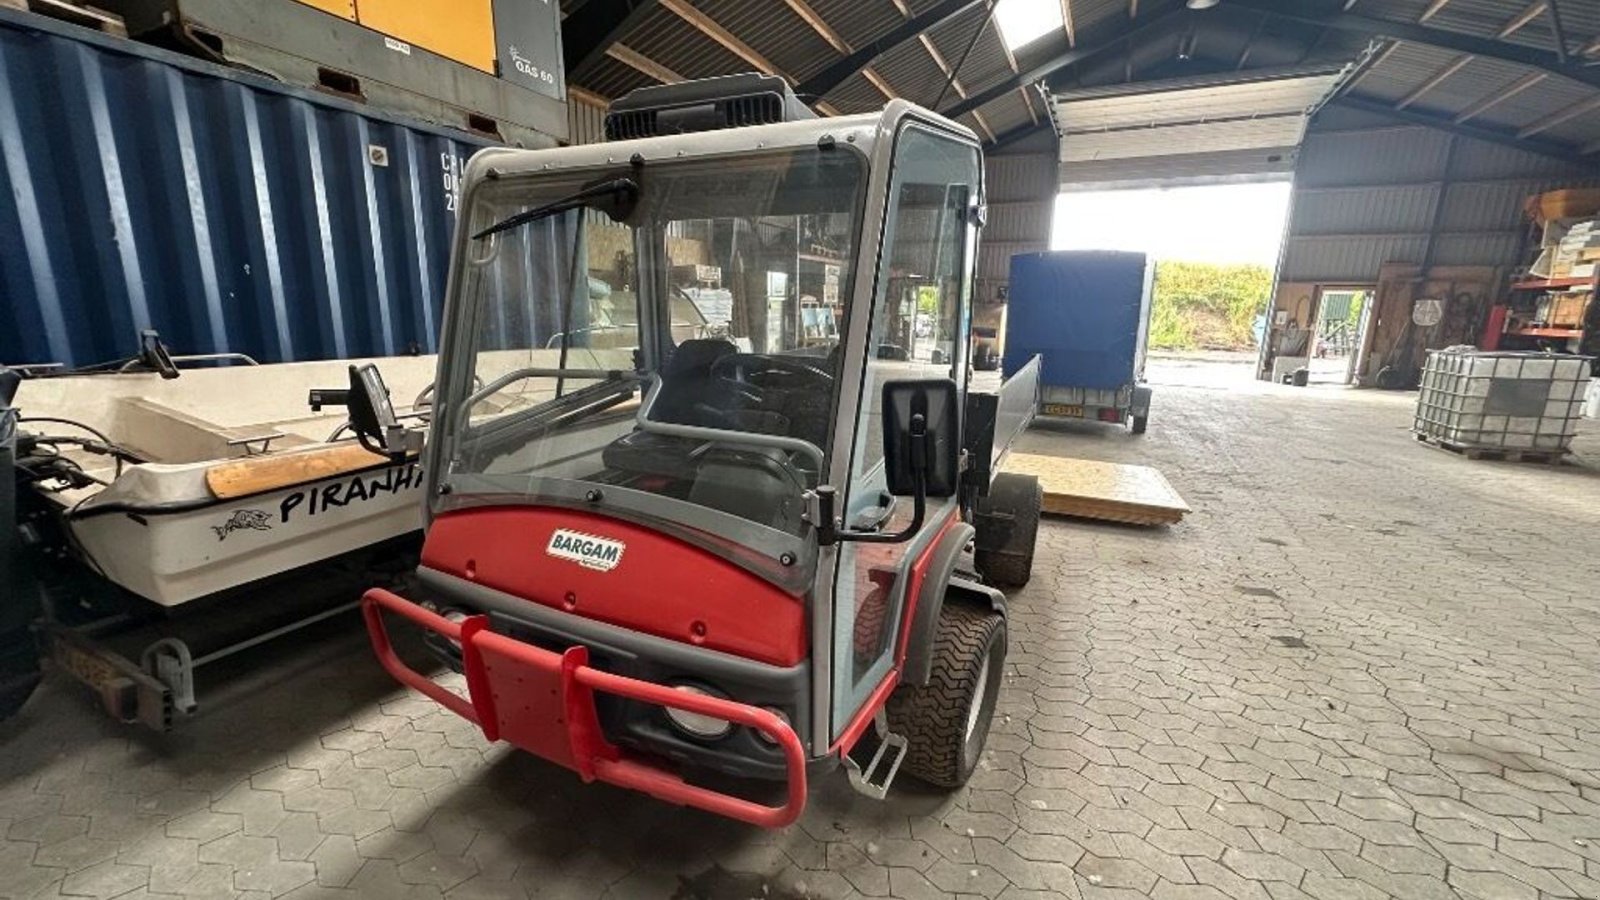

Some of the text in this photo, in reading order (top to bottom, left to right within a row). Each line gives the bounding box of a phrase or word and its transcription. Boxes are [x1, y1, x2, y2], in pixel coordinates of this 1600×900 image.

[515, 60, 553, 84] QAS 60
[552, 534, 618, 562] BARGAM
